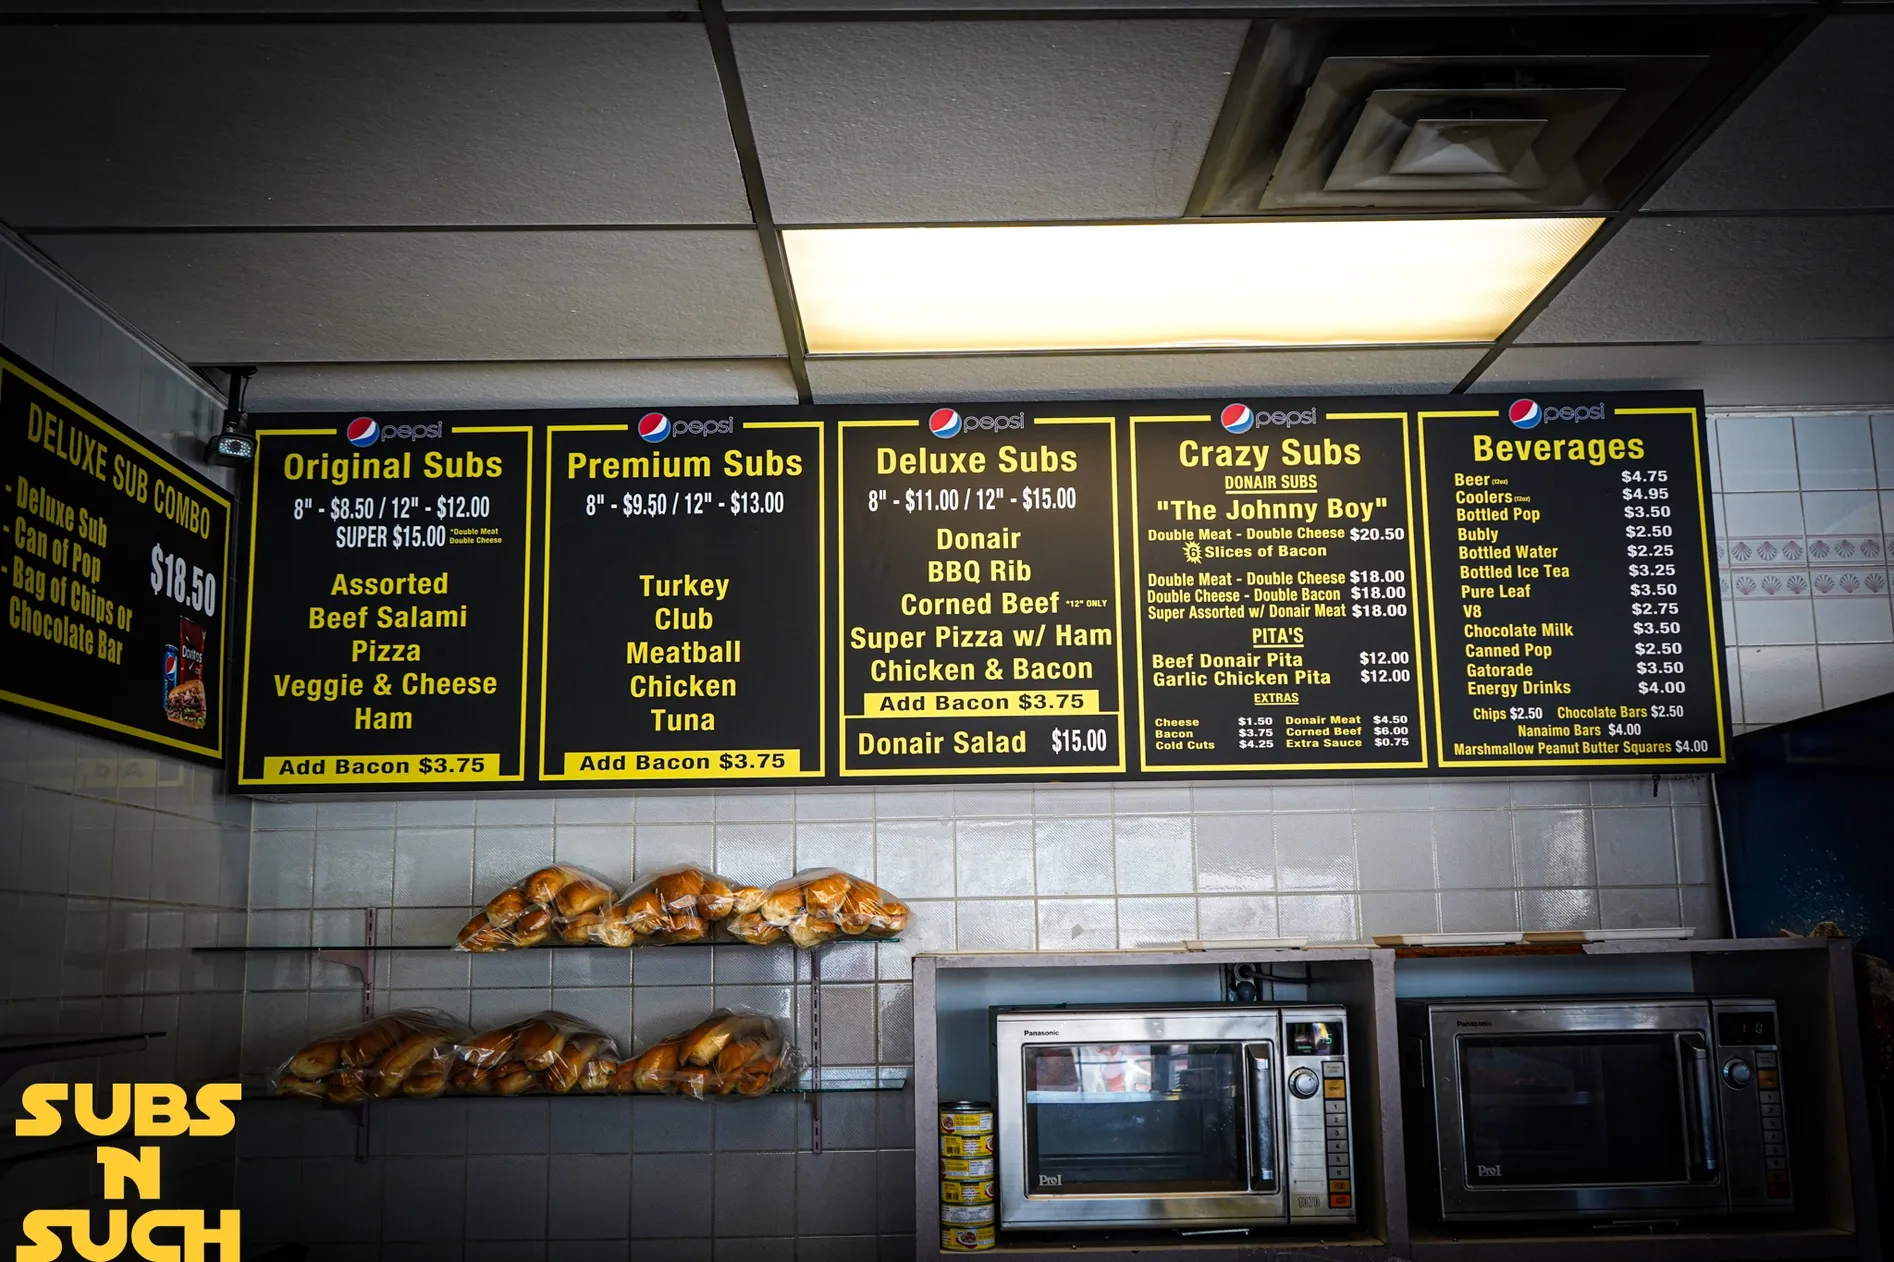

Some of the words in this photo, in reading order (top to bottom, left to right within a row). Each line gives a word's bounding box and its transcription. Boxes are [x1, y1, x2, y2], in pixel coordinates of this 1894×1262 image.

[964, 412, 1024, 433] pepsi
[1256, 407, 1316, 428] pepsi
[1544, 402, 1605, 424] pepsi
[381, 421, 442, 442] pepsi
[672, 416, 733, 437] pepsi
[878, 448, 985, 474] Deluxe
[999, 446, 1077, 472] Subs
[1180, 440, 1269, 472] Crazy
[1282, 438, 1360, 465] Subs
[1474, 435, 1644, 466] Beverages
[27, 402, 108, 481] DELUXE
[112, 454, 148, 504] SUB
[154, 479, 210, 540] COMBO
[285, 452, 410, 485] Original
[424, 452, 502, 478] Subs
[569, 451, 710, 478] Premium
[724, 450, 802, 476] Subs
[1225, 475, 1276, 489] DONAIR
[1281, 474, 1317, 488] SUBS
[1455, 473, 1490, 486] Beer
[1622, 470, 1667, 483] $4.75
[1456, 490, 1512, 504] Coolers
[1622, 488, 1668, 501] $4.95
[16, 475, 74, 533] Deluxe
[78, 507, 108, 549] Sub
[294, 498, 312, 520] 8"
[330, 496, 374, 522] $8.50
[392, 497, 418, 518] 12"
[437, 495, 489, 520] $12.00
[1158, 500, 1216, 520] "The
[1226, 500, 1317, 522] Johnny
[1328, 498, 1386, 522] Boy"
[1457, 508, 1508, 521] Bottled
[1514, 508, 1540, 523] Pop
[1624, 506, 1670, 519] $3.50
[336, 526, 387, 548] SUPER
[393, 524, 445, 549] $15.00
[938, 528, 1021, 549] Donair
[1148, 529, 1194, 540] Double
[1199, 529, 1232, 540] Meat
[1247, 528, 1292, 539] Double
[1297, 527, 1344, 538] Cheese
[1350, 528, 1404, 542] $20.50
[1458, 528, 1498, 543] Bubly
[1626, 525, 1672, 538] $2.50
[14, 516, 47, 554] Can
[52, 537, 68, 565] of
[72, 545, 101, 583] Pop
[1189, 547, 1197, 557] 6
[1205, 546, 1252, 558] Slices
[1258, 545, 1273, 557] of
[1278, 545, 1326, 556] Bacon
[150, 542, 216, 617] $18.50
[929, 560, 980, 583] BBQ
[991, 560, 1031, 581] Rib
[13, 555, 46, 602] Bag
[50, 577, 66, 606] of
[71, 580, 113, 626] Chips
[118, 605, 132, 632] or
[331, 572, 448, 595] Assorted
[640, 574, 729, 600] Turkey
[902, 593, 991, 615] Corned
[1002, 592, 1059, 614] Beef
[1148, 606, 1185, 622] Super
[1189, 605, 1244, 618] Assorted
[1249, 604, 1265, 618] w/
[1269, 604, 1310, 617] Donair
[1315, 604, 1346, 617] Meat
[1352, 604, 1407, 618] $18.00
[1463, 605, 1481, 618] V8
[1632, 602, 1678, 616] $2.75
[310, 606, 368, 629] Beef
[377, 605, 466, 628] Salami
[9, 595, 93, 656] Chocolate
[97, 635, 123, 666] Bar
[851, 627, 926, 653] Super
[936, 626, 1003, 647] Pizza
[1013, 624, 1046, 646] w/
[1056, 624, 1112, 646] Ham
[1253, 627, 1303, 643] PITA'S
[1464, 624, 1536, 638] Chocolate
[1542, 623, 1573, 636] Milk
[1634, 622, 1680, 635] $3.50
[182, 645, 202, 663] Doritos
[352, 640, 420, 662] Pizza
[627, 641, 740, 663] Meatball
[1153, 654, 1193, 668] Beef
[1200, 653, 1260, 668] Donair
[1267, 653, 1302, 667] Pita
[1360, 651, 1409, 666] $12.00
[1467, 663, 1532, 677] Gatorade
[1637, 662, 1684, 675] $3.50
[274, 674, 363, 701] Veggie
[373, 674, 391, 695] &
[403, 673, 496, 695] Cheese
[631, 675, 736, 697] Chicken
[880, 696, 924, 711] Add
[936, 696, 1008, 710] Bacon
[1019, 694, 1084, 710] $3.75
[1254, 692, 1299, 703] EXTRAS
[356, 708, 412, 729] Ham
[651, 709, 714, 731] Tuna
[1155, 718, 1199, 726] Cheese
[1238, 717, 1272, 726] $1.50
[1286, 716, 1326, 724] Donair
[1330, 716, 1361, 724] Meat
[1373, 715, 1408, 724] $4.50
[1474, 708, 1506, 722] Chips
[1510, 707, 1542, 720] $2.50
[1558, 706, 1616, 718] Chocolate
[1620, 706, 1647, 718] Bars
[1651, 705, 1684, 718] $2.50
[1156, 730, 1193, 738] Bacon
[1239, 728, 1273, 738] $3.75
[1286, 728, 1330, 736] Corned
[1334, 727, 1362, 735] Beef
[1374, 727, 1408, 736] $6.00
[1518, 724, 1570, 736] Nanaimo
[1574, 724, 1601, 736] Bars
[1608, 723, 1641, 736] $4.00
[859, 732, 944, 754] Donair
[954, 731, 1026, 753] Salad
[1052, 728, 1106, 754] $15.00
[1156, 741, 1183, 750] Cold
[1187, 741, 1215, 749] Cuts
[1239, 740, 1274, 749] $4.25
[1324, 739, 1362, 747] Sauce
[1375, 738, 1409, 747] $0.75
[1454, 743, 1534, 755] Marshmallow
[1538, 742, 1579, 754] Peanut
[1582, 742, 1619, 753] Butter
[1623, 741, 1672, 755] Squares
[1675, 740, 1708, 753] $4.00
